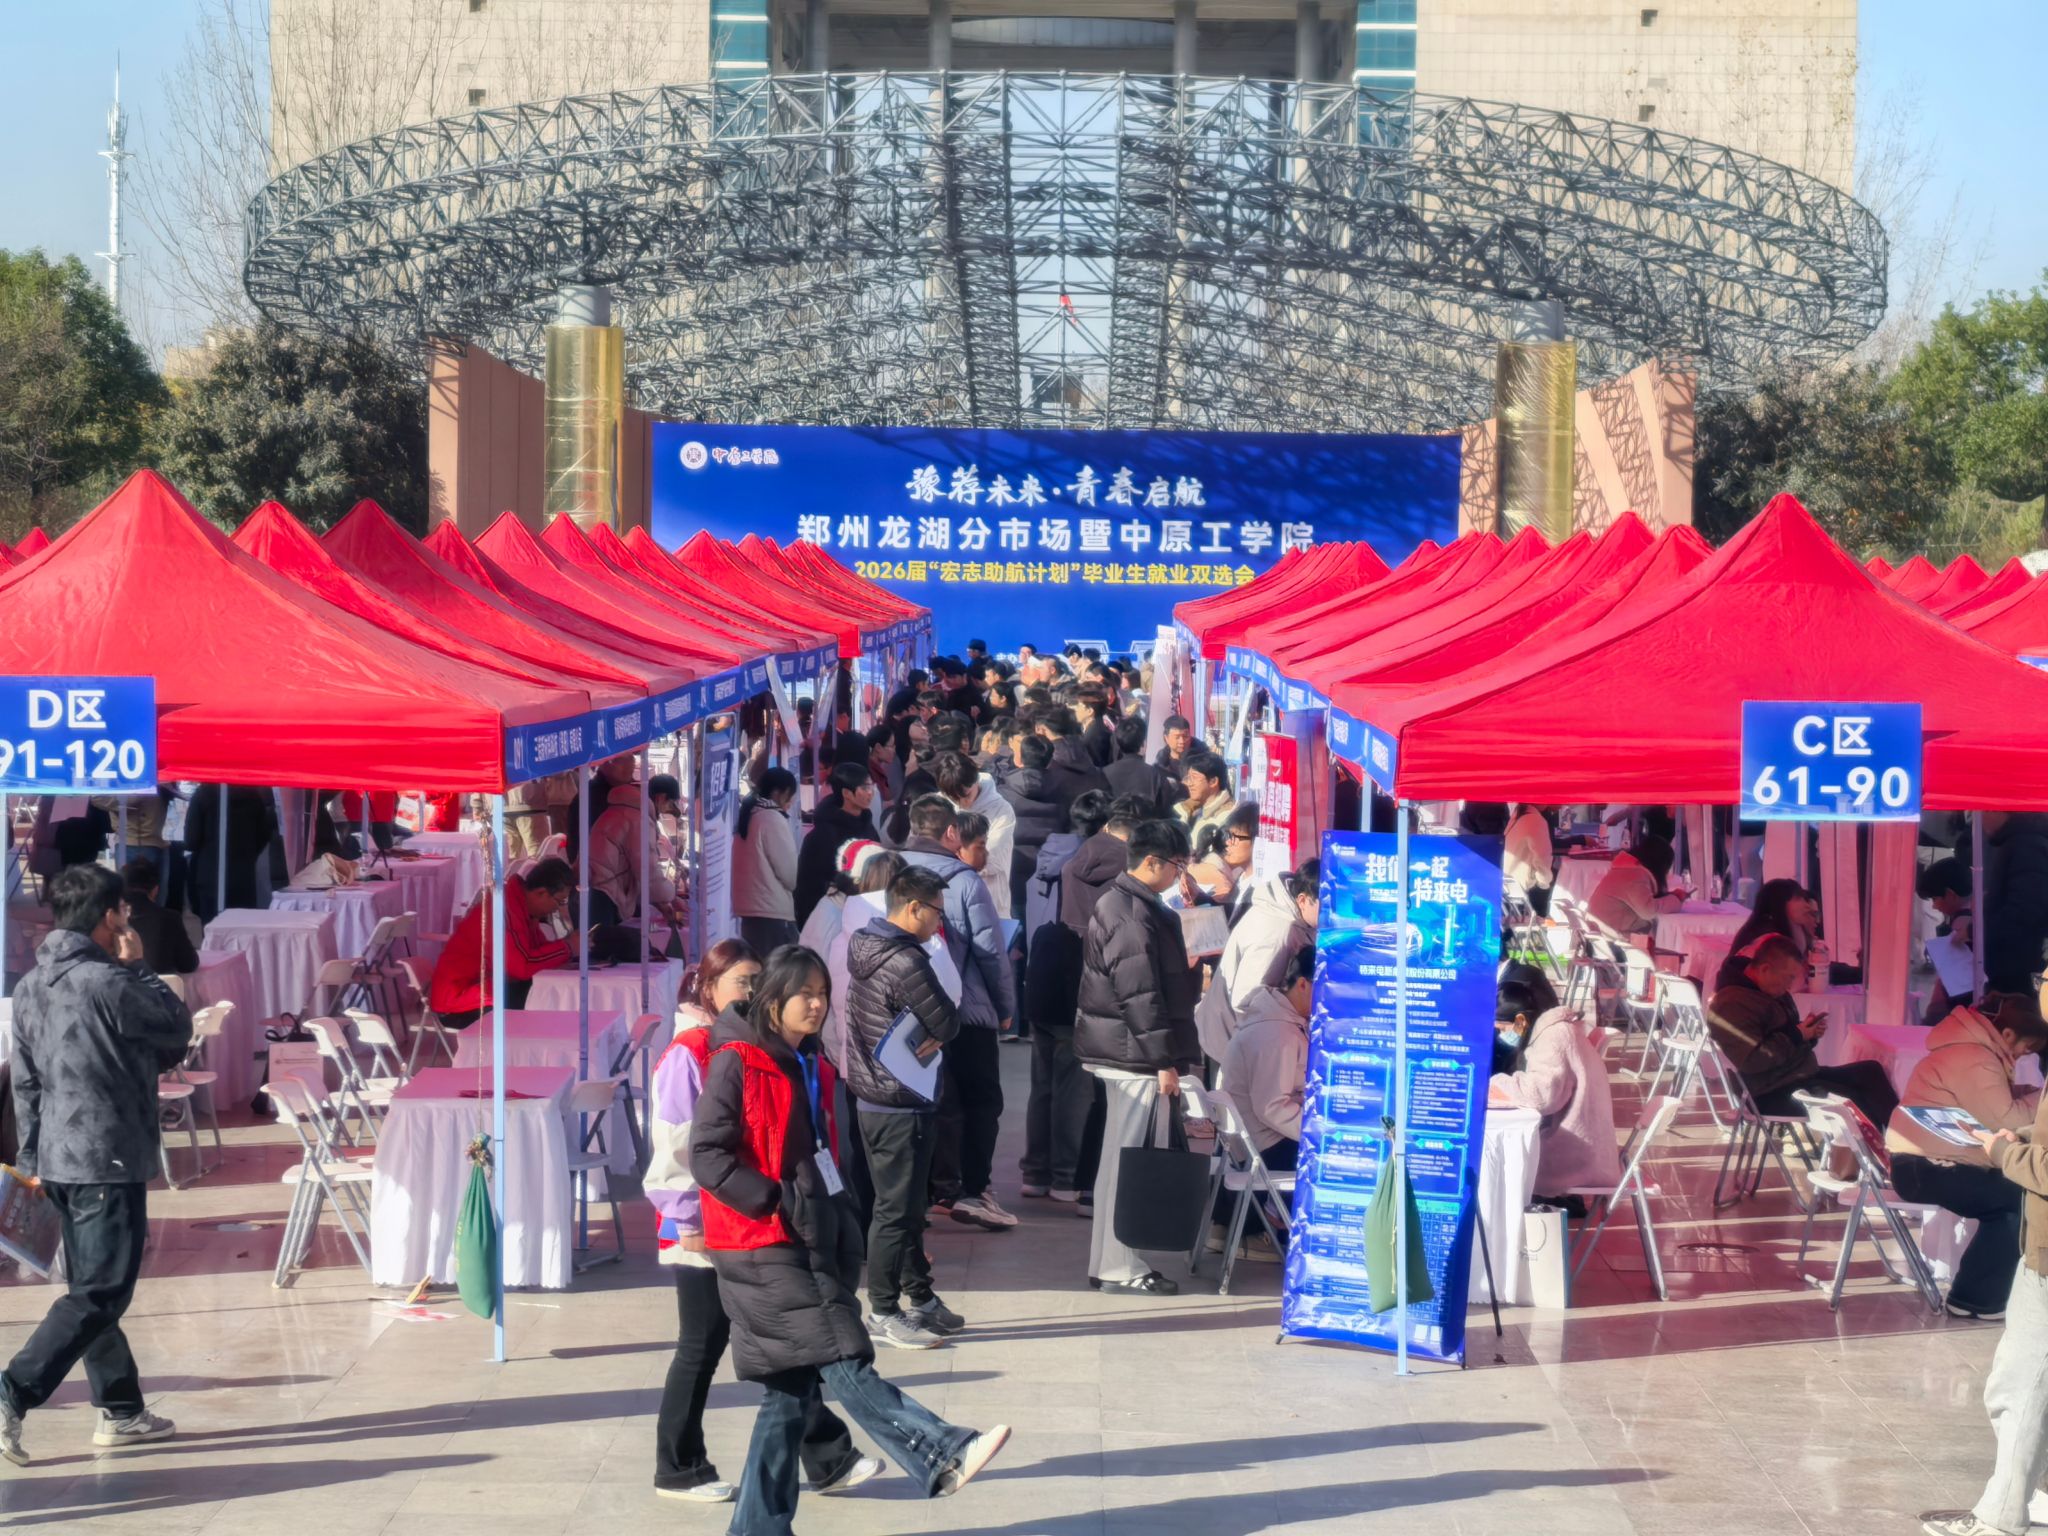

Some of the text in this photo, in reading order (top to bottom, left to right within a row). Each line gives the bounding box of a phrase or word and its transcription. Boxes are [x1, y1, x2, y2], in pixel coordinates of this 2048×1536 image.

[797, 514, 1314, 554] 郑州龙湖分市场暨中原工学院
[854, 560, 1256, 586] 2026届“宏志助航计划”毕业生就业双选会
[28, 689, 107, 729] D区
[1793, 715, 1872, 756] C区
[0, 739, 146, 780] 91-120
[1752, 765, 1910, 808] 61-90
[1409, 877, 1469, 909] 特来电
